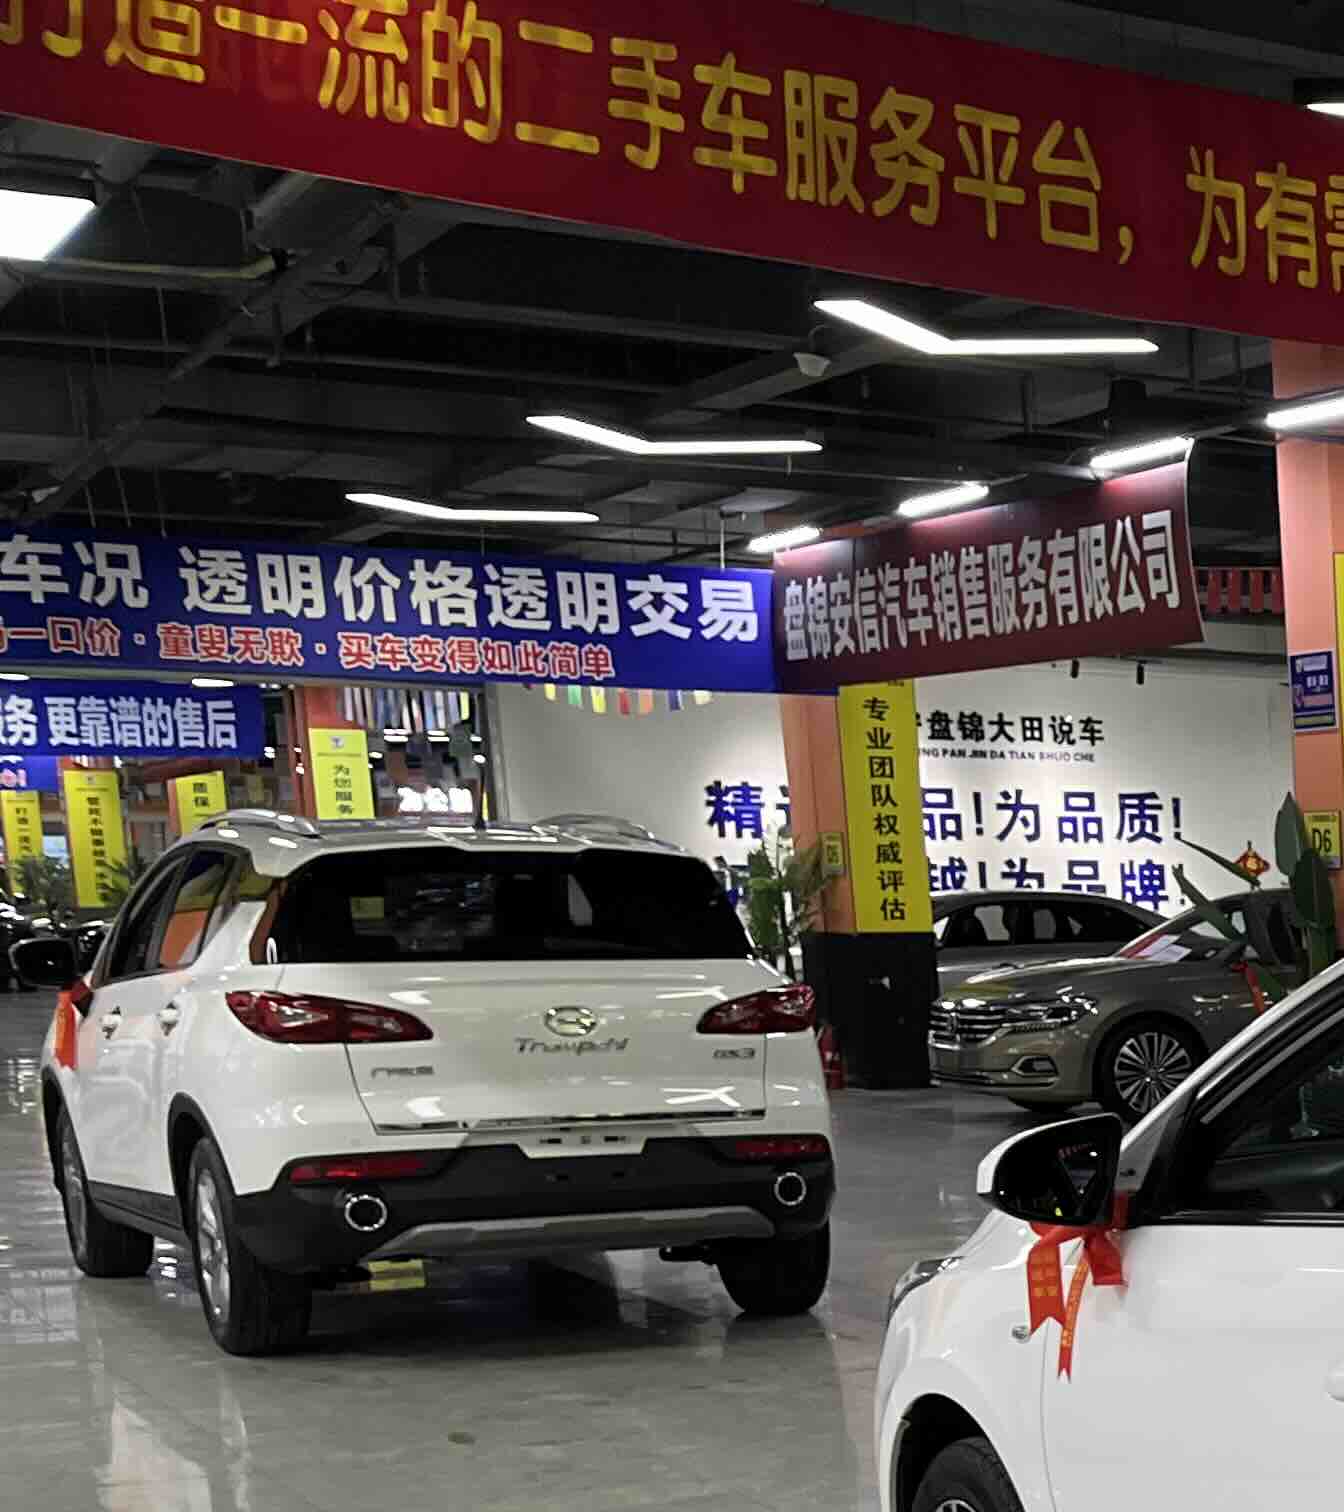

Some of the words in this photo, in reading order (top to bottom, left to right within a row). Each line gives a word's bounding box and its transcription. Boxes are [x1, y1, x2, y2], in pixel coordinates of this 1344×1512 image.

[0, 534, 149, 609] 车况
[178, 546, 760, 643] 透明价格透明交易
[784, 509, 1181, 662] 盘锦安信汽车销售服务有限公司
[0, 694, 38, 748] 务
[44, 696, 238, 749] 更靠谱的售后
[916, 709, 1105, 747] 盘锦大田说车
[990, 750, 1006, 760] DA
[863, 697, 907, 922] 专业团队权威评估
[1312, 828, 1332, 853] D6
